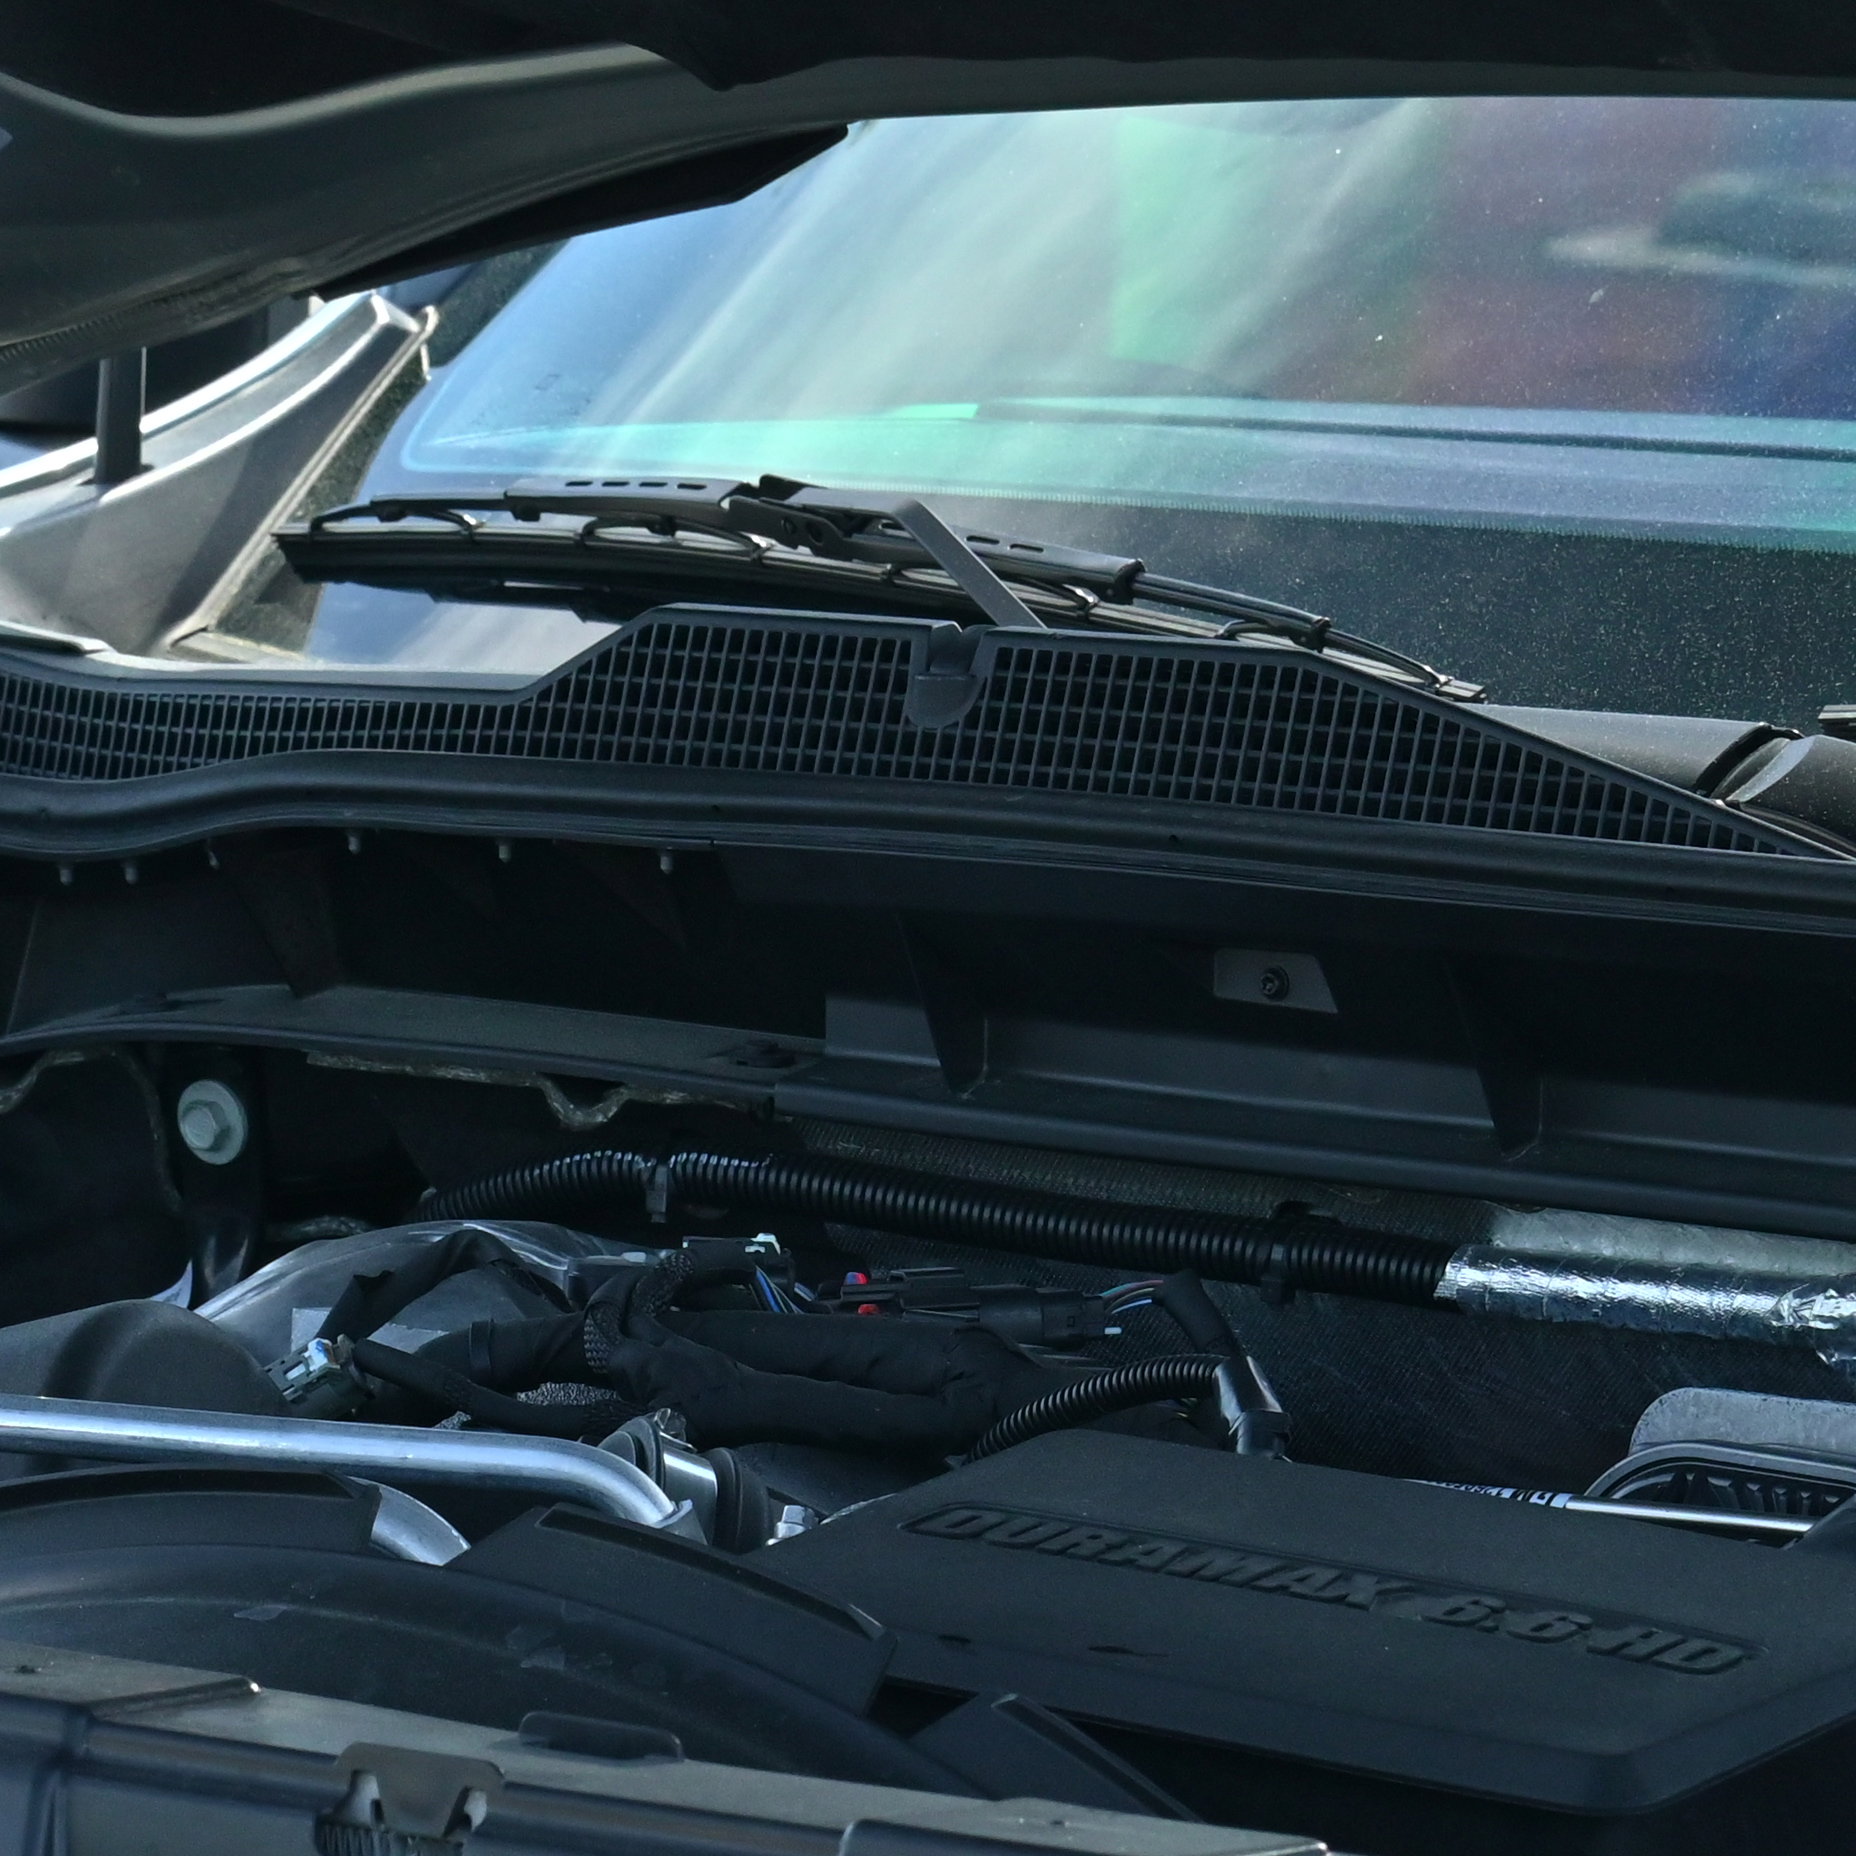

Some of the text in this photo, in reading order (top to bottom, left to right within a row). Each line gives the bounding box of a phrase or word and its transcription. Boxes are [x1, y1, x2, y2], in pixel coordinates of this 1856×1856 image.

[917, 1507, 1746, 1676] DURAMAX 6.6 HD
